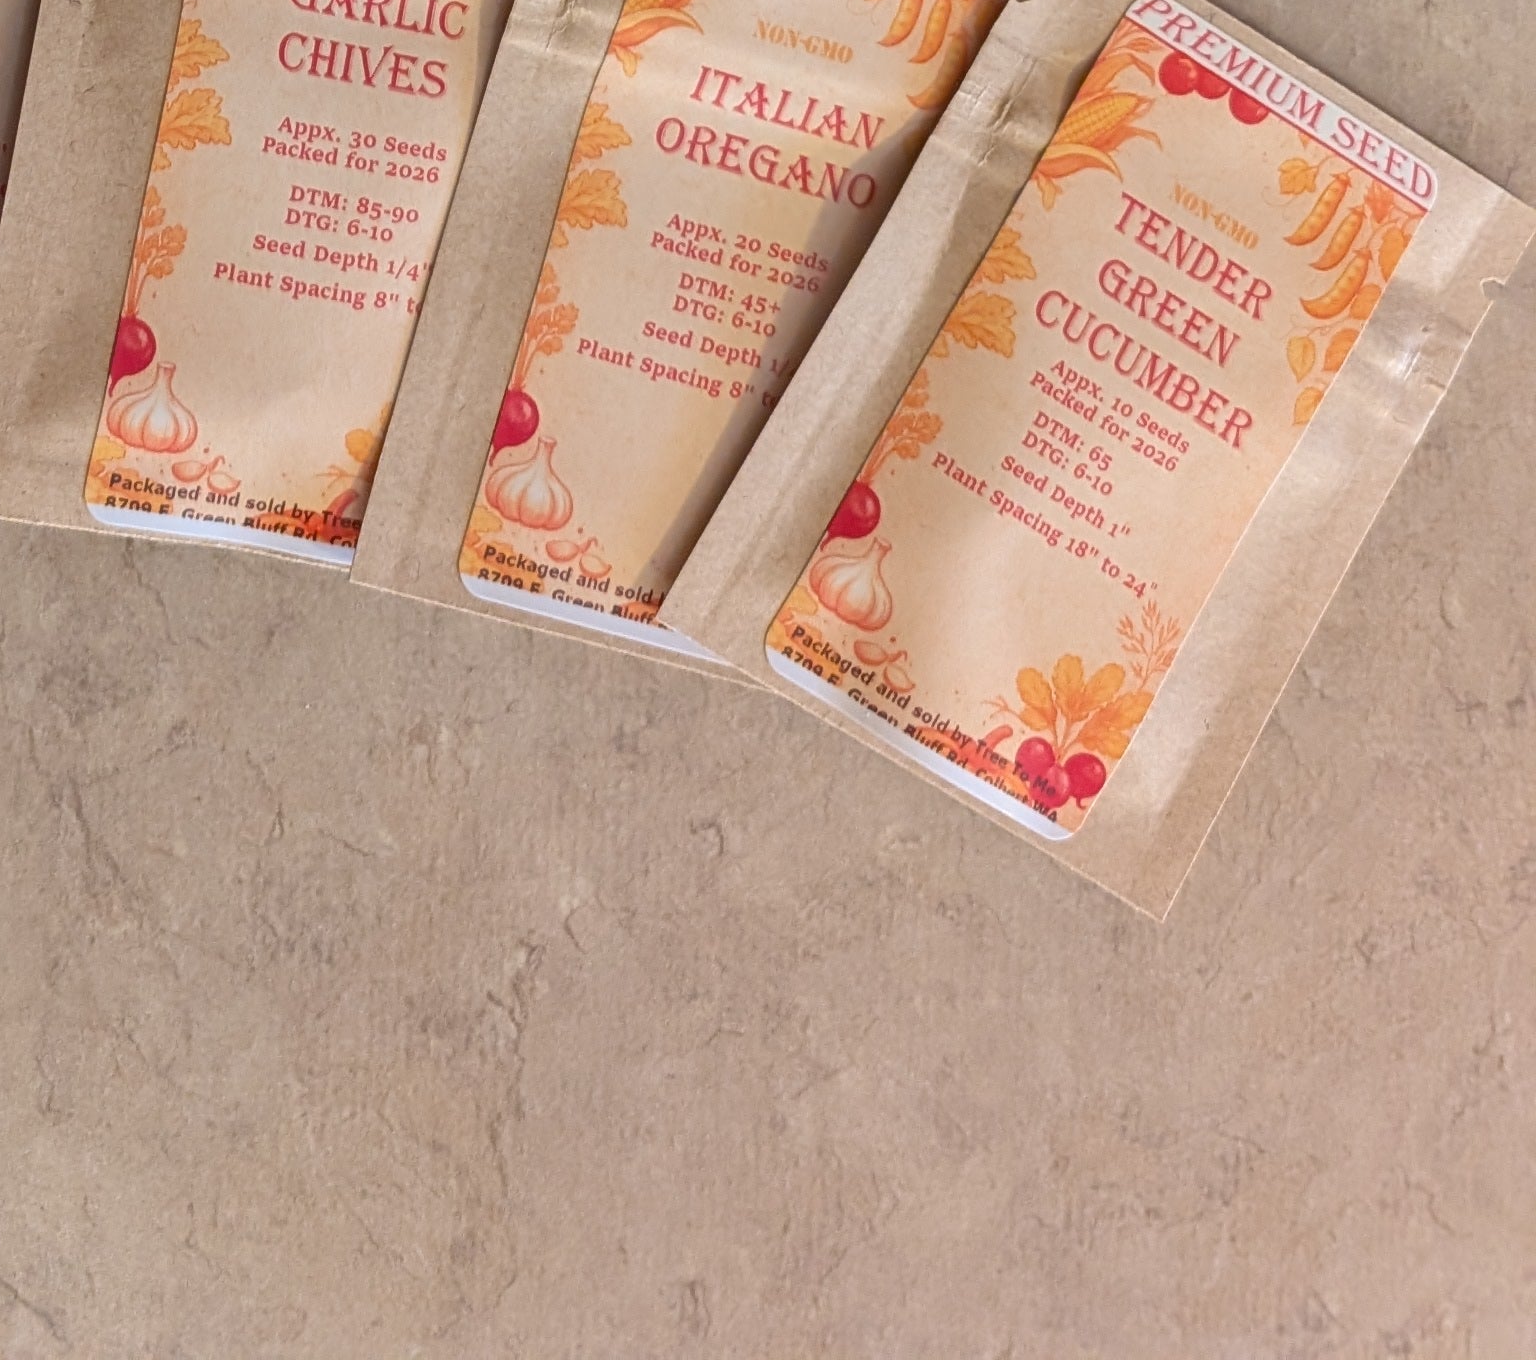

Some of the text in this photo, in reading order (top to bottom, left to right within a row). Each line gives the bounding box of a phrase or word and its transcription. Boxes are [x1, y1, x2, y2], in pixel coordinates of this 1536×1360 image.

[278, 32, 447, 99] CHIVES
[751, 18, 854, 64] NON-GMO
[277, 116, 447, 162] Appx. 30 Seeds
[689, 65, 885, 150] ITALIAN
[655, 117, 875, 207] OREGANO
[1330, 116, 1433, 200] SEED
[284, 207, 394, 243] DTG: 6-10
[289, 184, 419, 224] DTM: 85-90
[213, 262, 274, 289] Plant
[279, 275, 367, 311] Spacing
[650, 231, 819, 292] Packed for 2026
[1114, 191, 1273, 321] TENDER
[672, 294, 776, 337] DTG: 6-10
[678, 272, 781, 315] DTM: 45+
[1098, 259, 1241, 368] GREEN
[1035, 290, 1253, 449] CUCUMBER
[1029, 370, 1180, 472] Packed for 2026
[1050, 359, 1190, 454] Appx. 10 Seeds
[1021, 429, 1113, 496] DTG: 6-10
[1032, 410, 1113, 472] DTM: 65
[1000, 455, 1050, 494] Seed
[1049, 484, 1105, 529] Depth
[482, 544, 657, 610] Packaged and sold
